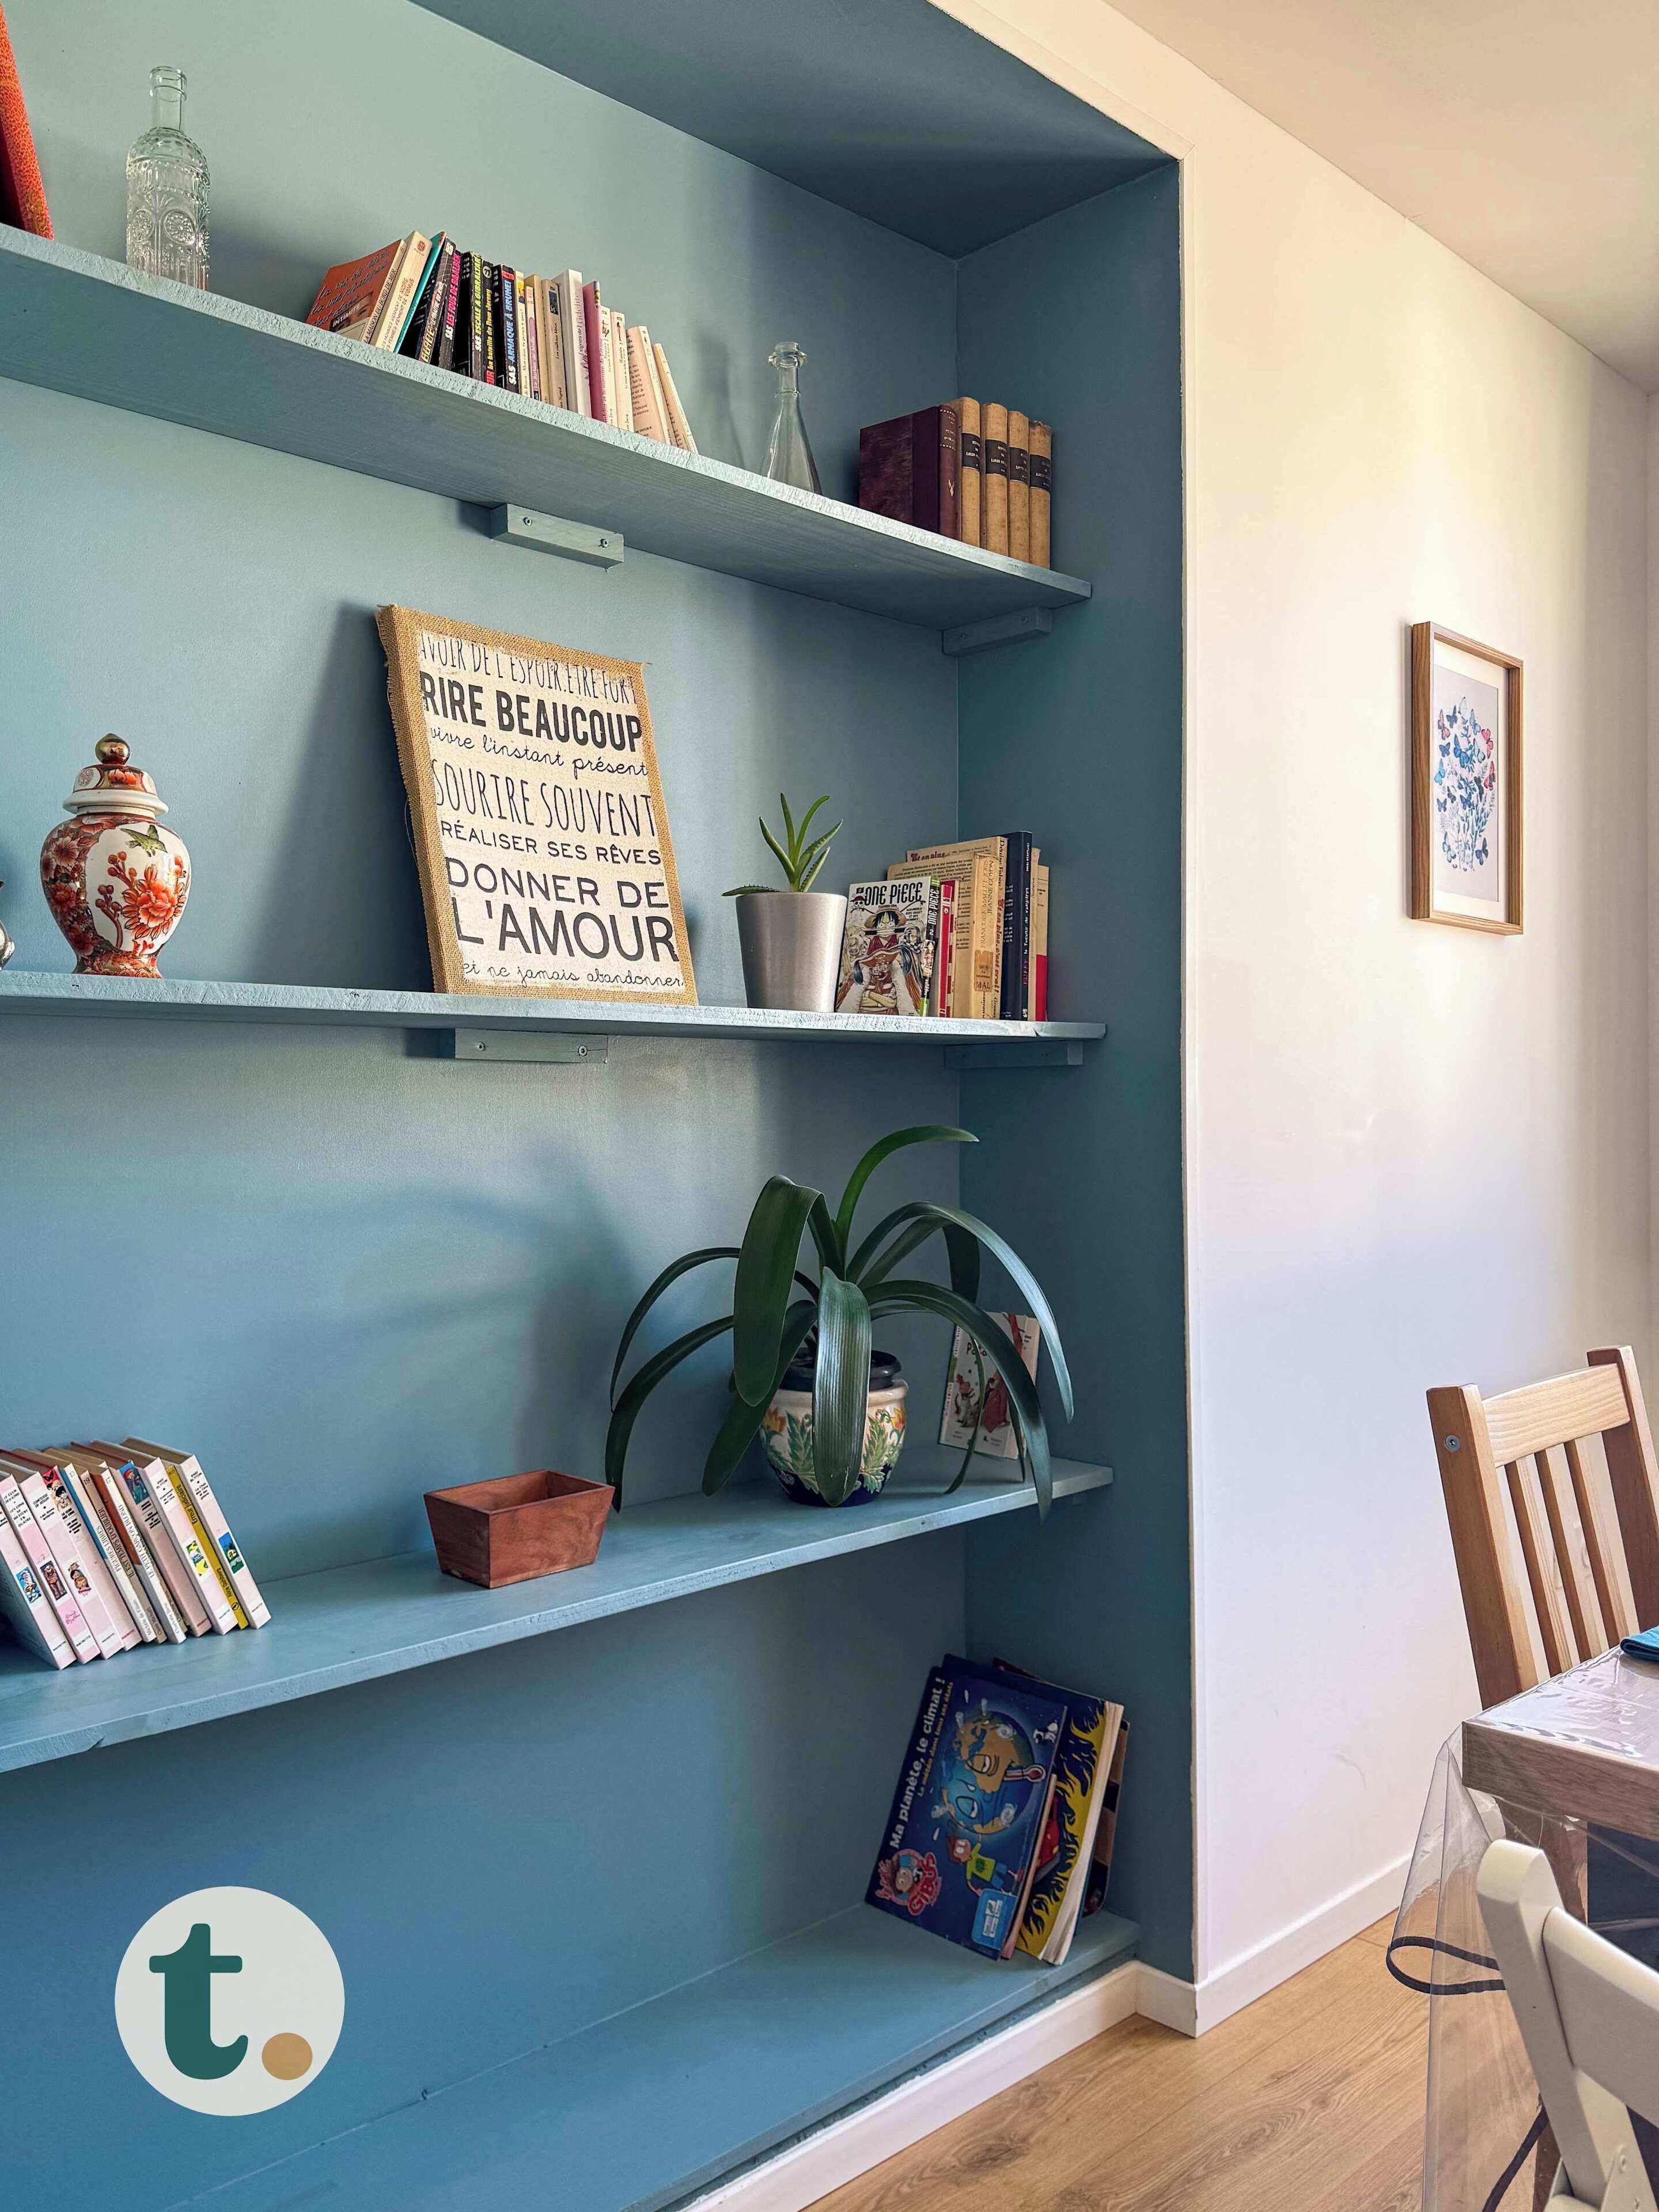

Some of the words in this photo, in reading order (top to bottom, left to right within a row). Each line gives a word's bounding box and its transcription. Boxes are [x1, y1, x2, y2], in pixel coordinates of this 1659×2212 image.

[388, 268, 396, 282] MER
[451, 252, 461, 286] BAALBEK
[385, 281, 392, 290] DE
[450, 284, 457, 296] DE
[504, 279, 512, 311] BRUNEI
[378, 289, 388, 305] BORD
[448, 294, 457, 313] FOUS
[374, 305, 381, 314] DU
[446, 312, 454, 326] LES
[366, 313, 378, 335] MAISON
[445, 325, 453, 340] SAS
[486, 327, 493, 335] du
[505, 321, 515, 363] ARNAQUE
[507, 365, 517, 385] SAS
[421, 634, 466, 671] AVOIR
[471, 643, 491, 676] DE
[603, 670, 637, 704] FORT
[419, 670, 486, 728] RIRE
[496, 690, 642, 752] BEAUCOUP
[430, 727, 475, 749] vivre
[483, 734, 565, 766] l'instant
[572, 756, 649, 779] présent
[431, 758, 535, 826] SOURIRE
[540, 782, 656, 837] SOUVENT
[441, 820, 538, 854] RÉALISER
[547, 840, 588, 861] SES
[596, 844, 662, 865] RÊVES
[445, 856, 601, 907] DONNER
[616, 880, 669, 909] DE
[864, 885, 887, 906] ONE
[930, 889, 940, 910] PIECE
[927, 908, 937, 926] ONE
[996, 911, 1002, 923] en
[451, 896, 680, 963] L'AMOUR
[462, 960, 480, 975] et
[487, 966, 510, 978] ne
[516, 965, 581, 988] jamais
[586, 970, 684, 987] abandonner.
[976, 981, 990, 990] MAL
[176, 1483, 191, 1509] judiciaire
[98, 1506, 117, 1540] D'OUBLIER
[118, 1503, 131, 1527] BLOND
[187, 1506, 198, 1524] Erreur
[96, 1524, 109, 1547] LIBRES
[128, 1525, 144, 1554] GARÇON
[107, 1545, 122, 1572] FIGURES
[113, 1537, 126, 1560] TEMPS
[123, 1558, 131, 1571] EST
[141, 1551, 151, 1570] PETIT
[128, 1569, 134, 1578] IL
[149, 1568, 154, 1578] LE
[921, 1686, 942, 1734] climat
[916, 1736, 930, 1753] le
[896, 1755, 925, 1822] planète,
[889, 1822, 904, 1849] Ma
